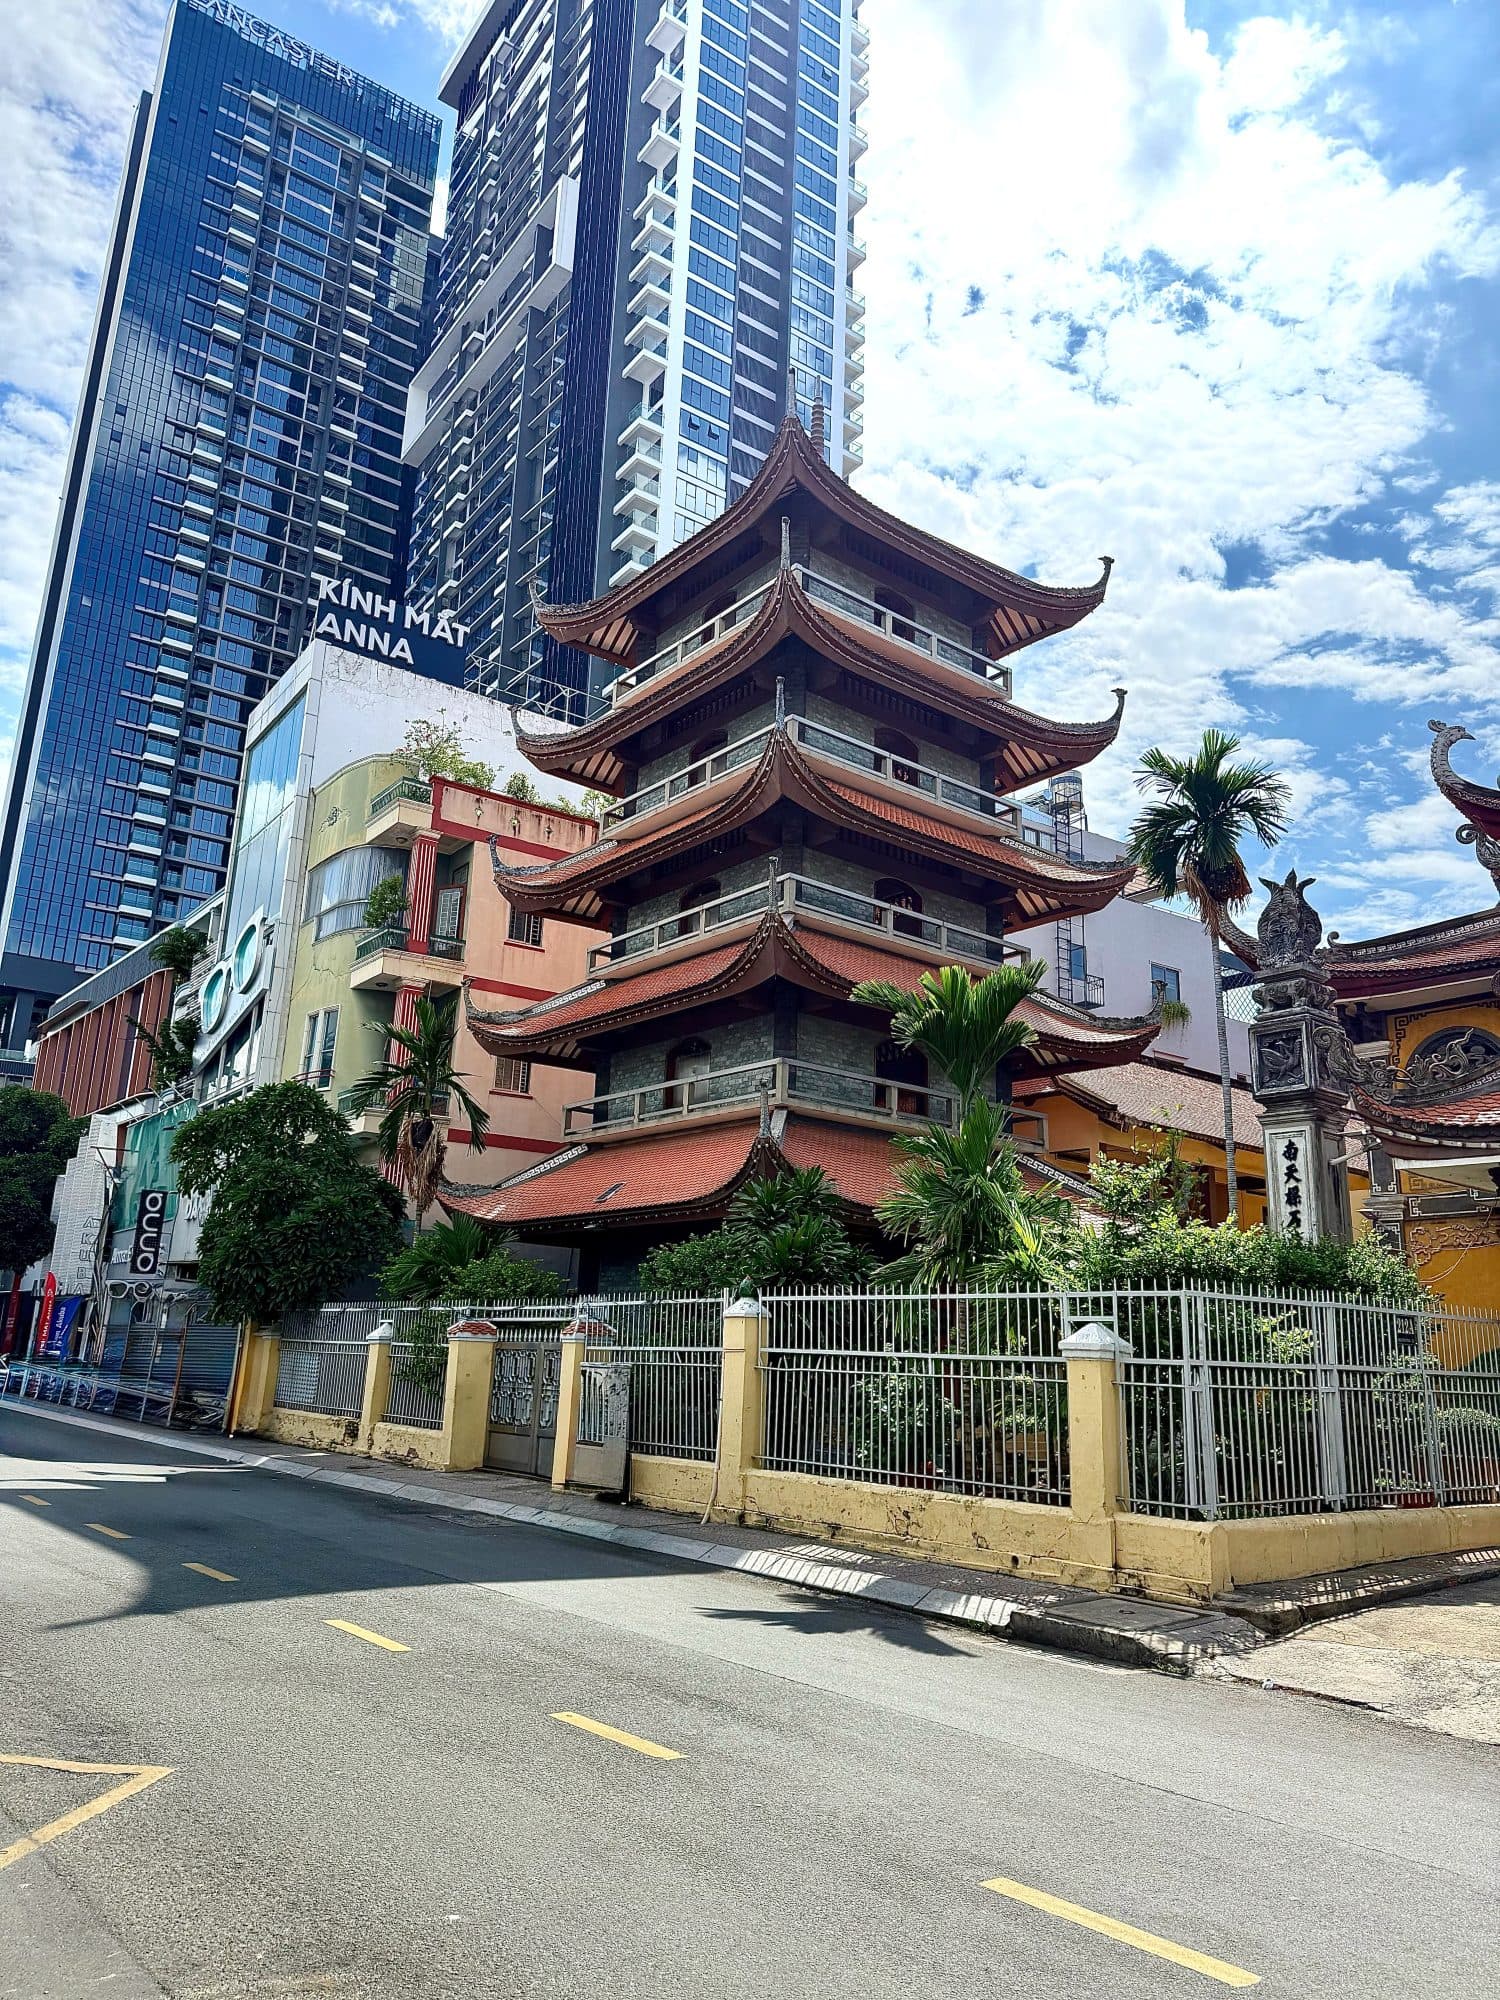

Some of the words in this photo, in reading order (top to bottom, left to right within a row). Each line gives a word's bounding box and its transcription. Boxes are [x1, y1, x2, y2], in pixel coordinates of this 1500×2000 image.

[190, 0, 354, 87] ANCASTER
[320, 577, 396, 624] KÍNH
[316, 612, 414, 665] ANNA
[137, 1192, 163, 1272] anna
